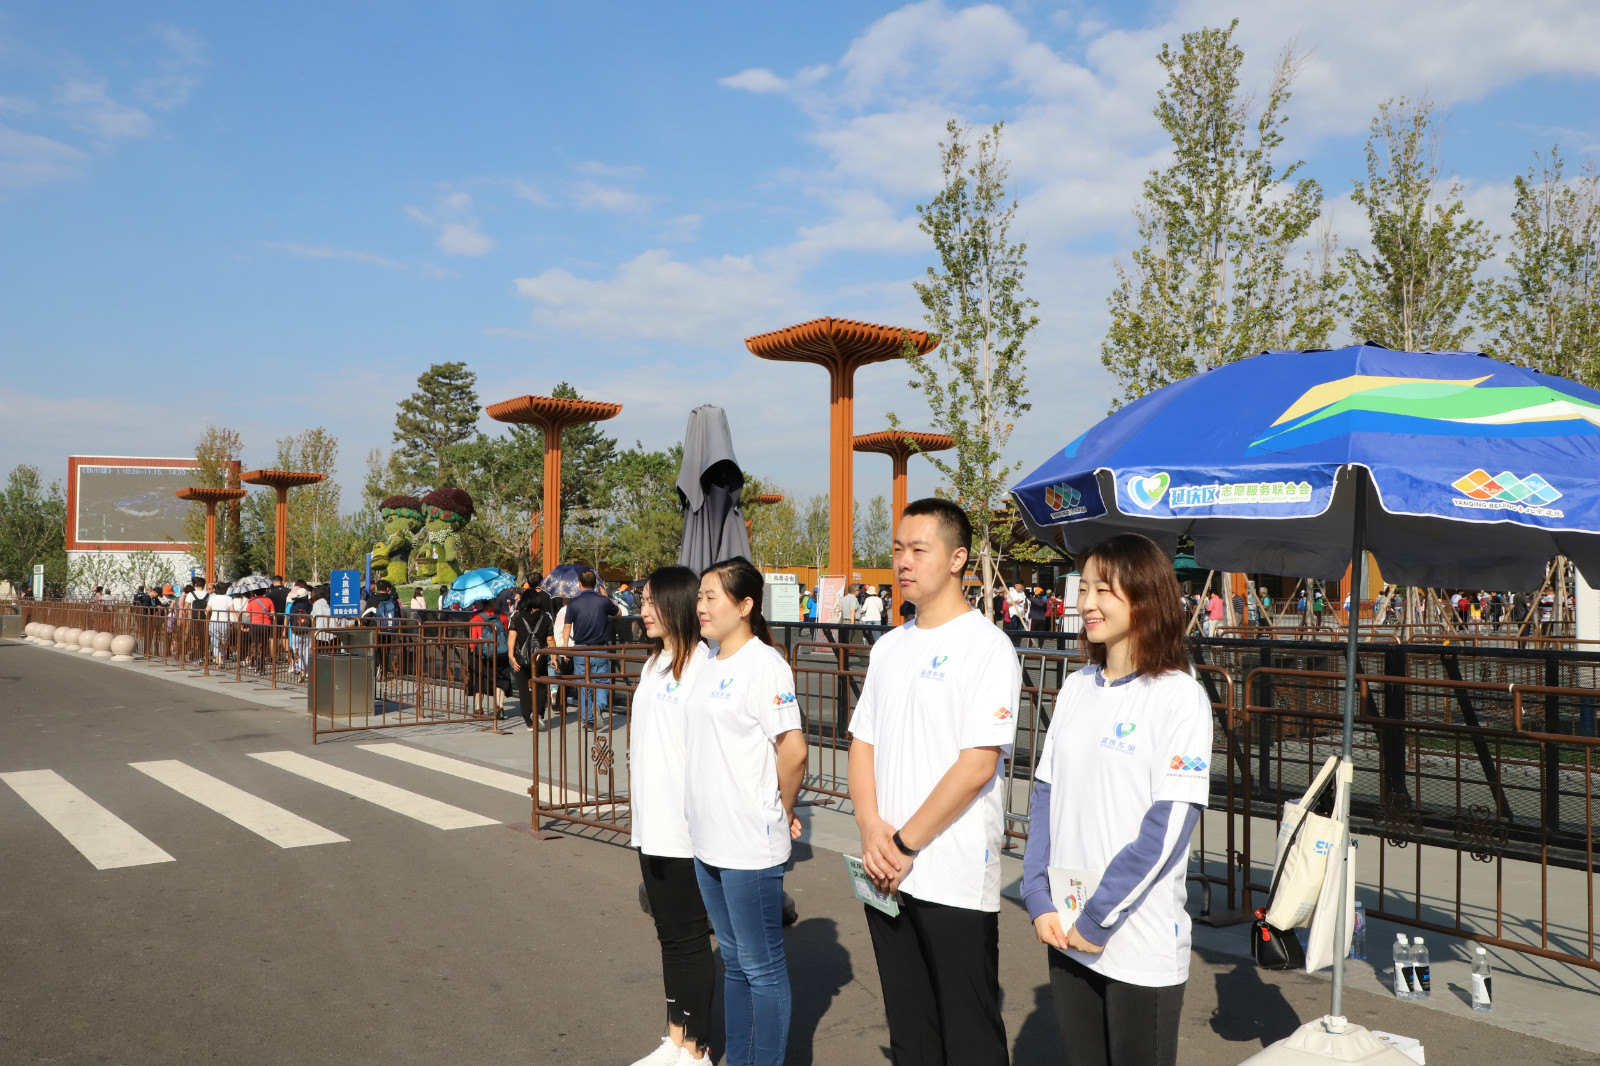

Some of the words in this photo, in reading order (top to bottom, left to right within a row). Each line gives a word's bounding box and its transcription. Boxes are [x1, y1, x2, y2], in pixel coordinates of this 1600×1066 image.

[1171, 486, 1217, 506] 延庆区
[1221, 483, 1310, 497] 志愿服务联合会
[1454, 499, 1487, 508] YANQING
[1489, 502, 1517, 511] BEIJING
[342, 572, 350, 604] 人员通道
